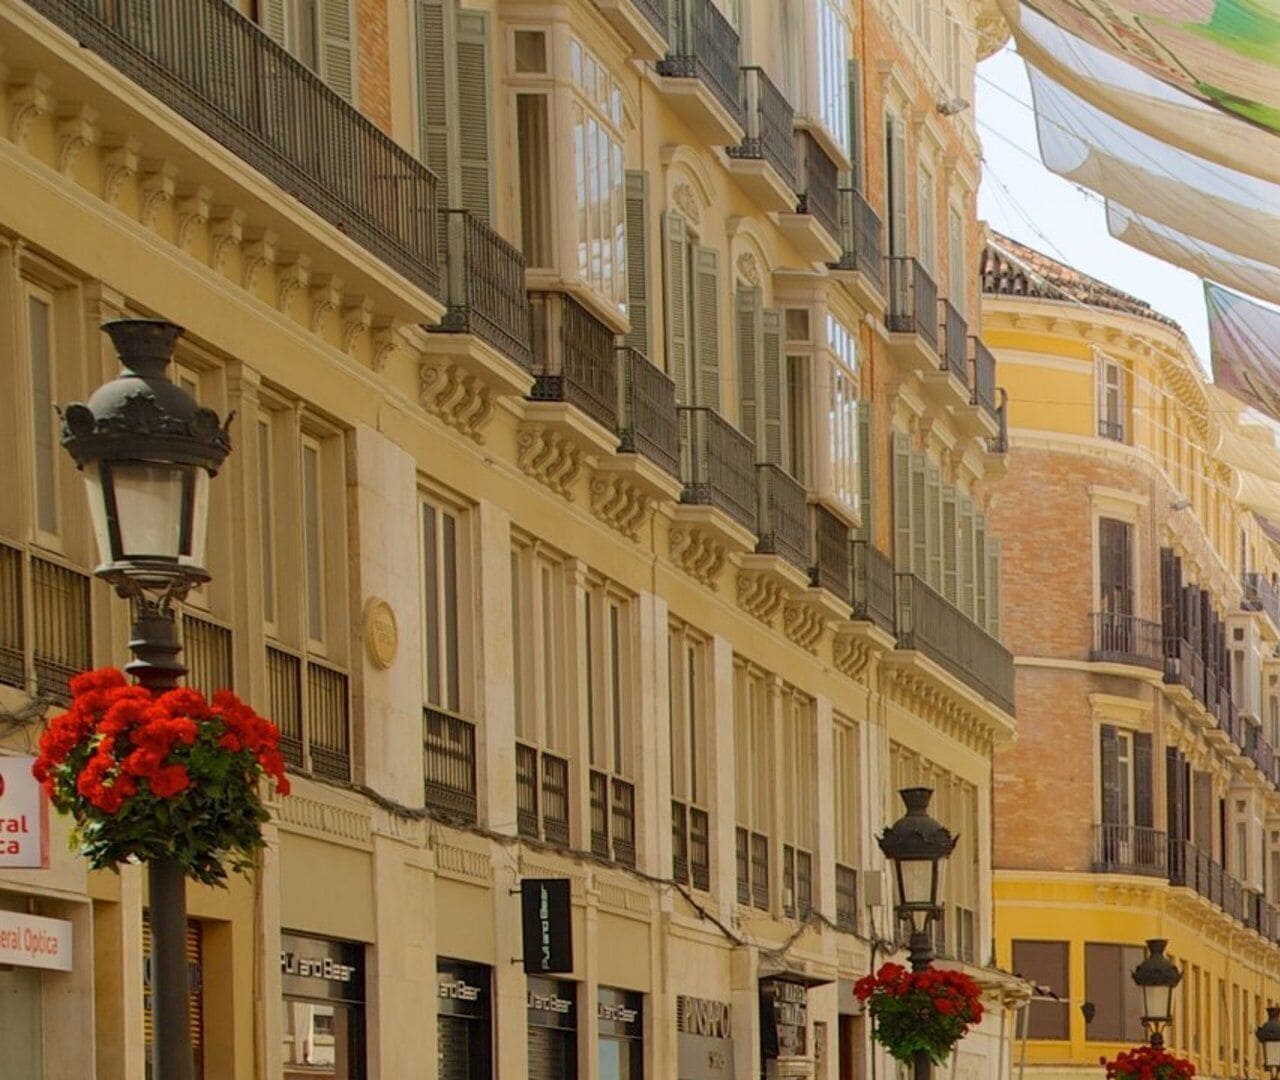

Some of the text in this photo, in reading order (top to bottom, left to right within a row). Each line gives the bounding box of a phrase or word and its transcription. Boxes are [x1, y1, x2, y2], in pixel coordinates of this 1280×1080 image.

[540, 883, 548, 919] Bear
[541, 920, 549, 945] and
[299, 959, 322, 978] and
[323, 958, 356, 982] Bear
[458, 979, 481, 1001] Bear
